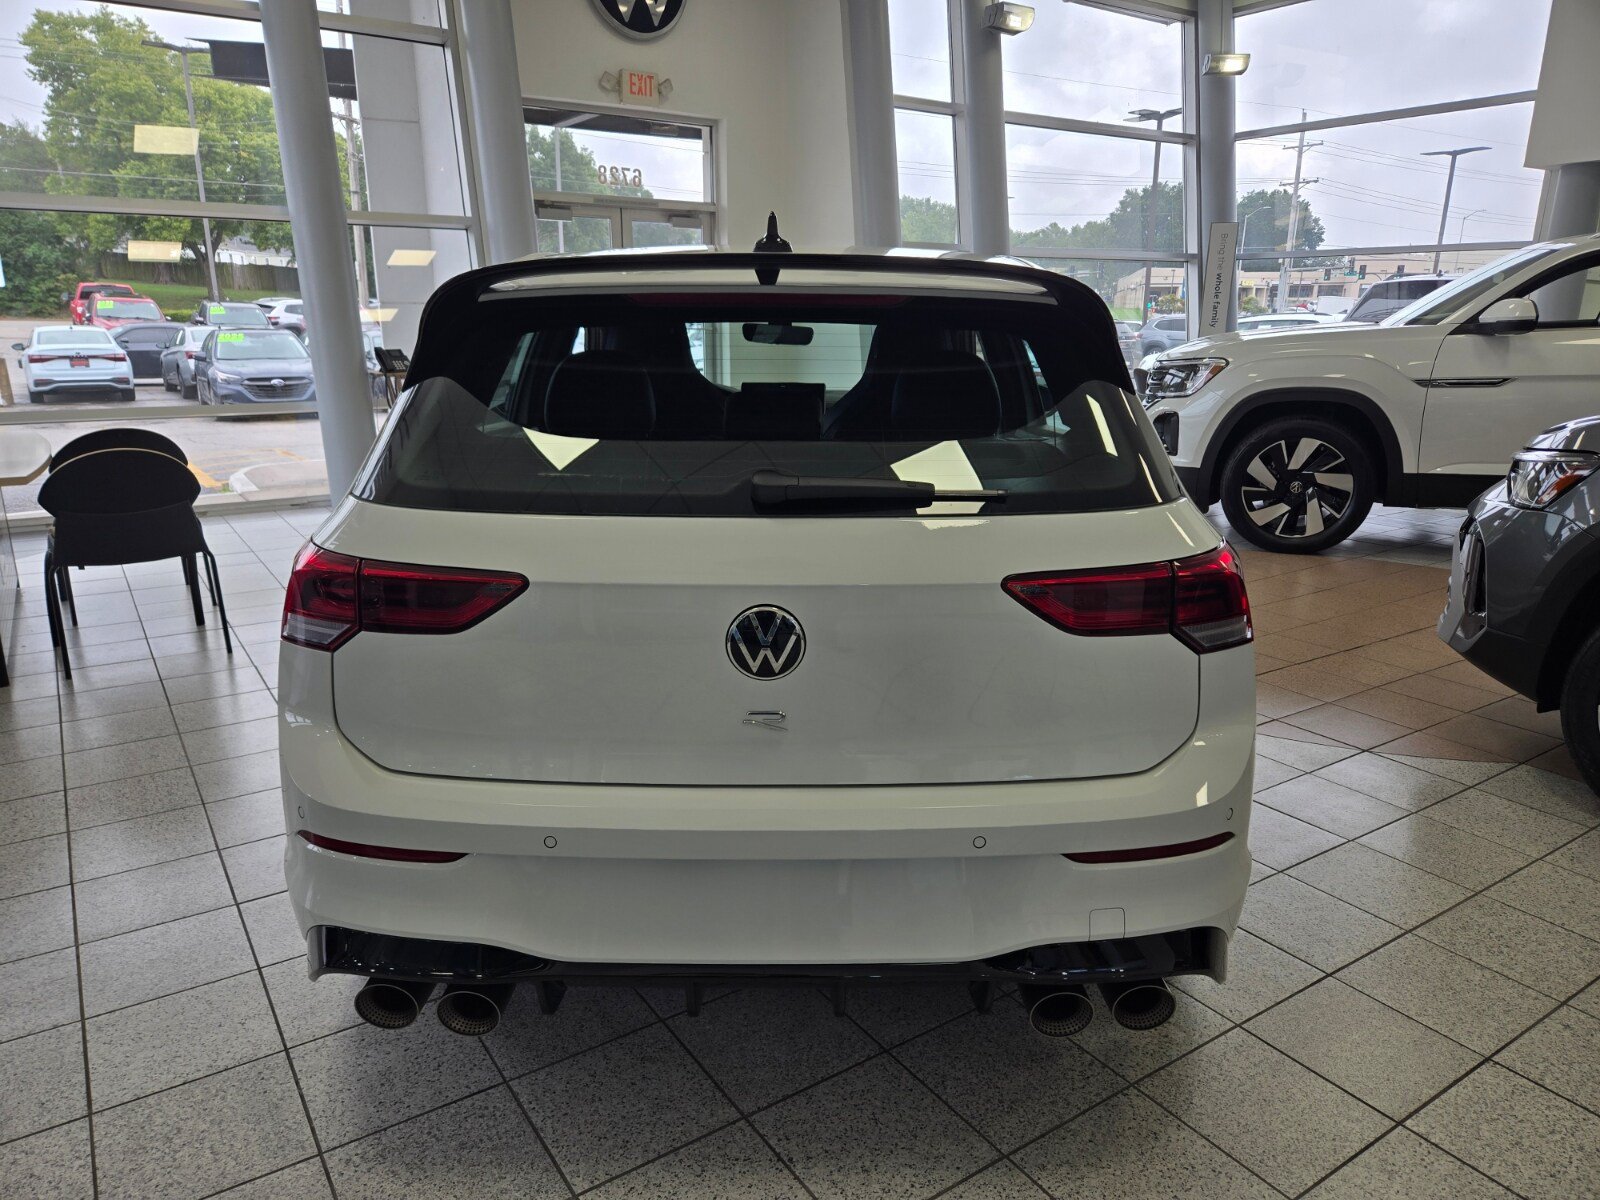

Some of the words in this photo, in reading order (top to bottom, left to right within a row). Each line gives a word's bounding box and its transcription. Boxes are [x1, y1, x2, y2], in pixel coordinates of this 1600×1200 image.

[629, 72, 654, 97] EXIT
[1217, 233, 1228, 254] Bring
[1217, 256, 1225, 271] the
[1213, 272, 1223, 299] whole
[1209, 301, 1221, 328] family
[729, 609, 801, 675] VW
